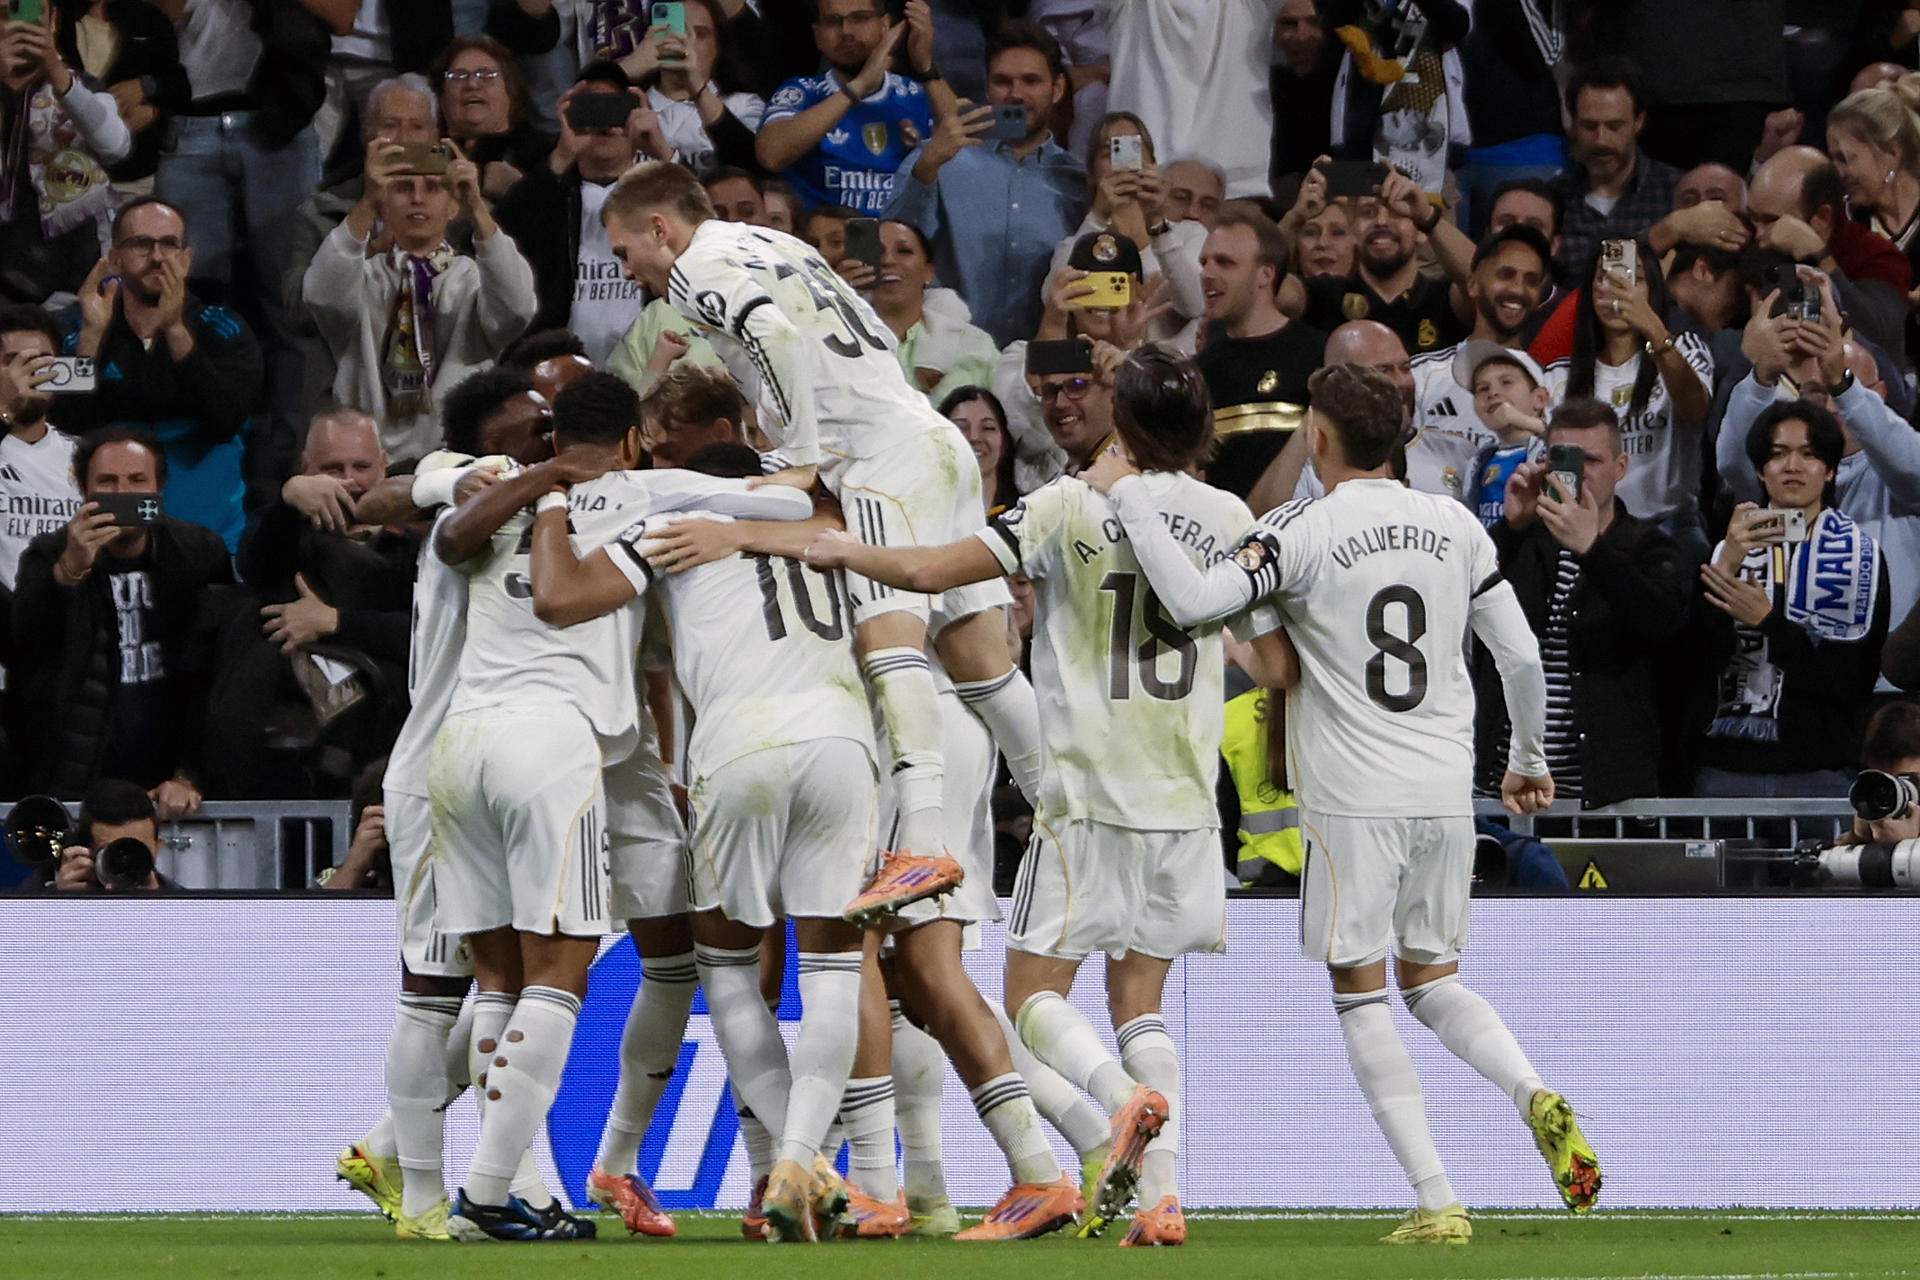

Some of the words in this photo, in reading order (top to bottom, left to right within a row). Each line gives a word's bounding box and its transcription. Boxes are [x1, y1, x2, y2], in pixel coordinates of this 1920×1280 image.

[589, 281, 638, 300] BETTER
[8, 518, 31, 536] FLY
[1073, 540, 1104, 564] A.
[1331, 524, 1451, 570] VALVERDE
[1099, 572, 1198, 700] 18
[1365, 584, 1428, 713] 8
